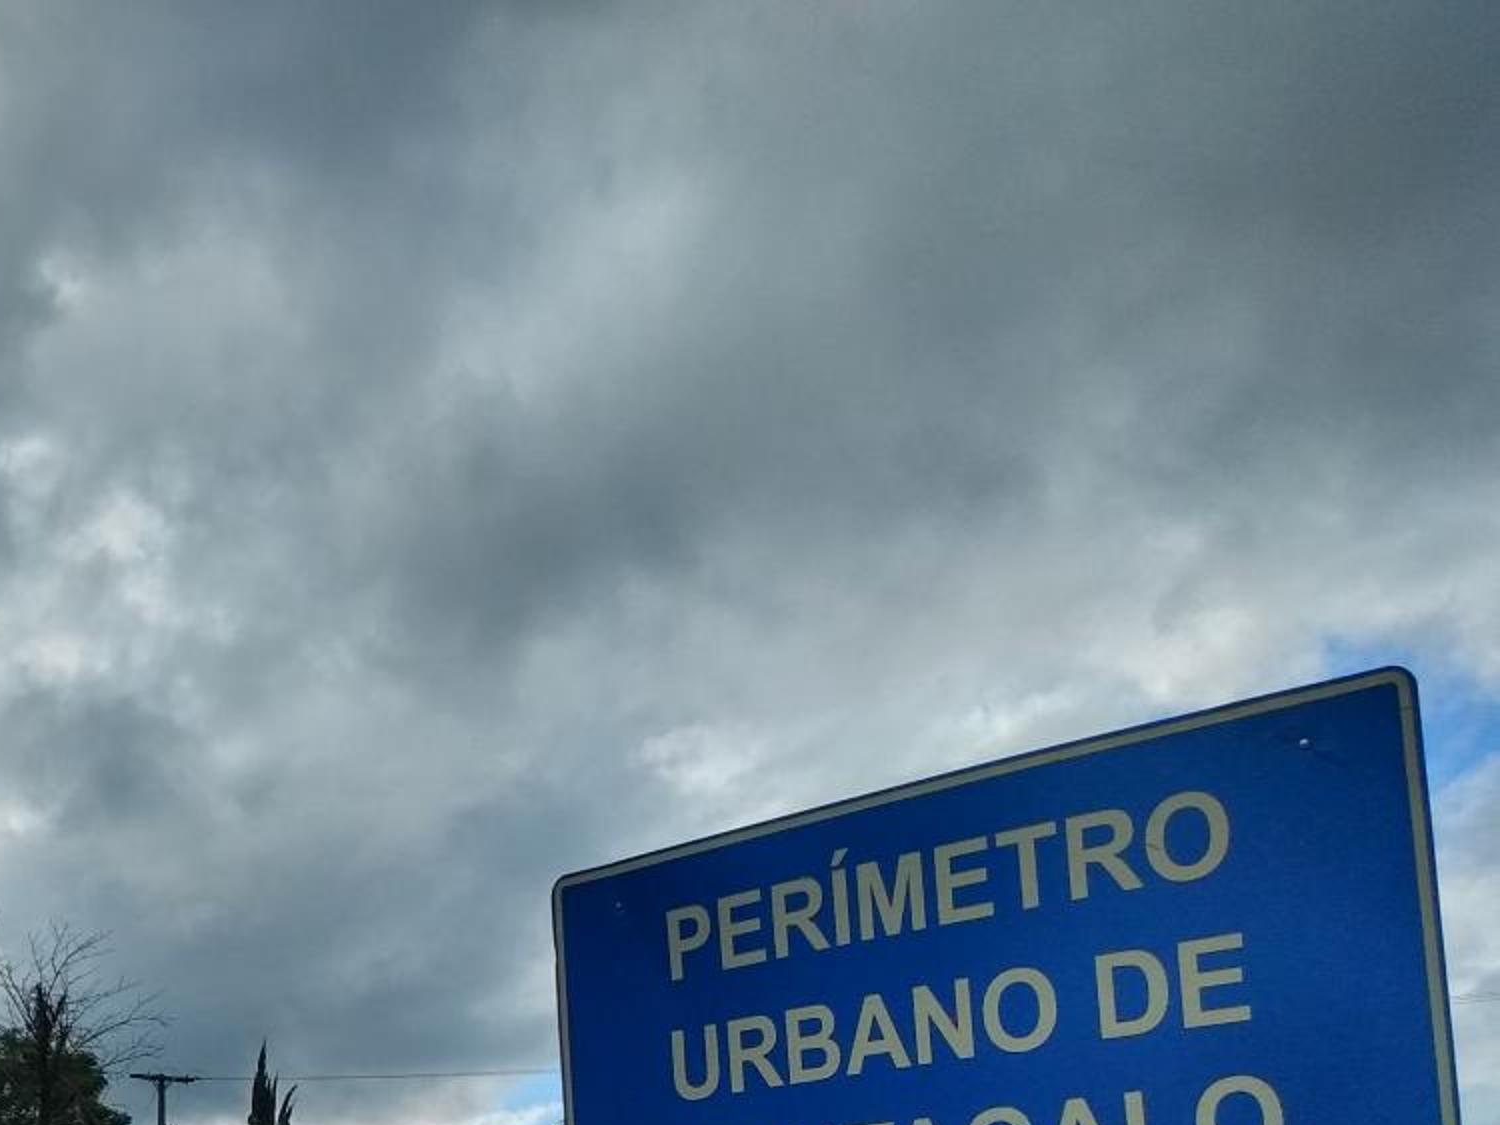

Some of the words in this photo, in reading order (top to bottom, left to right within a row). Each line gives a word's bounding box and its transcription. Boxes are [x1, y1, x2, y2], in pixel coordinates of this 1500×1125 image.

[665, 791, 1231, 981] PERÍMETRO
[671, 967, 1058, 1101] URBANO
[1095, 932, 1252, 1040] DE
